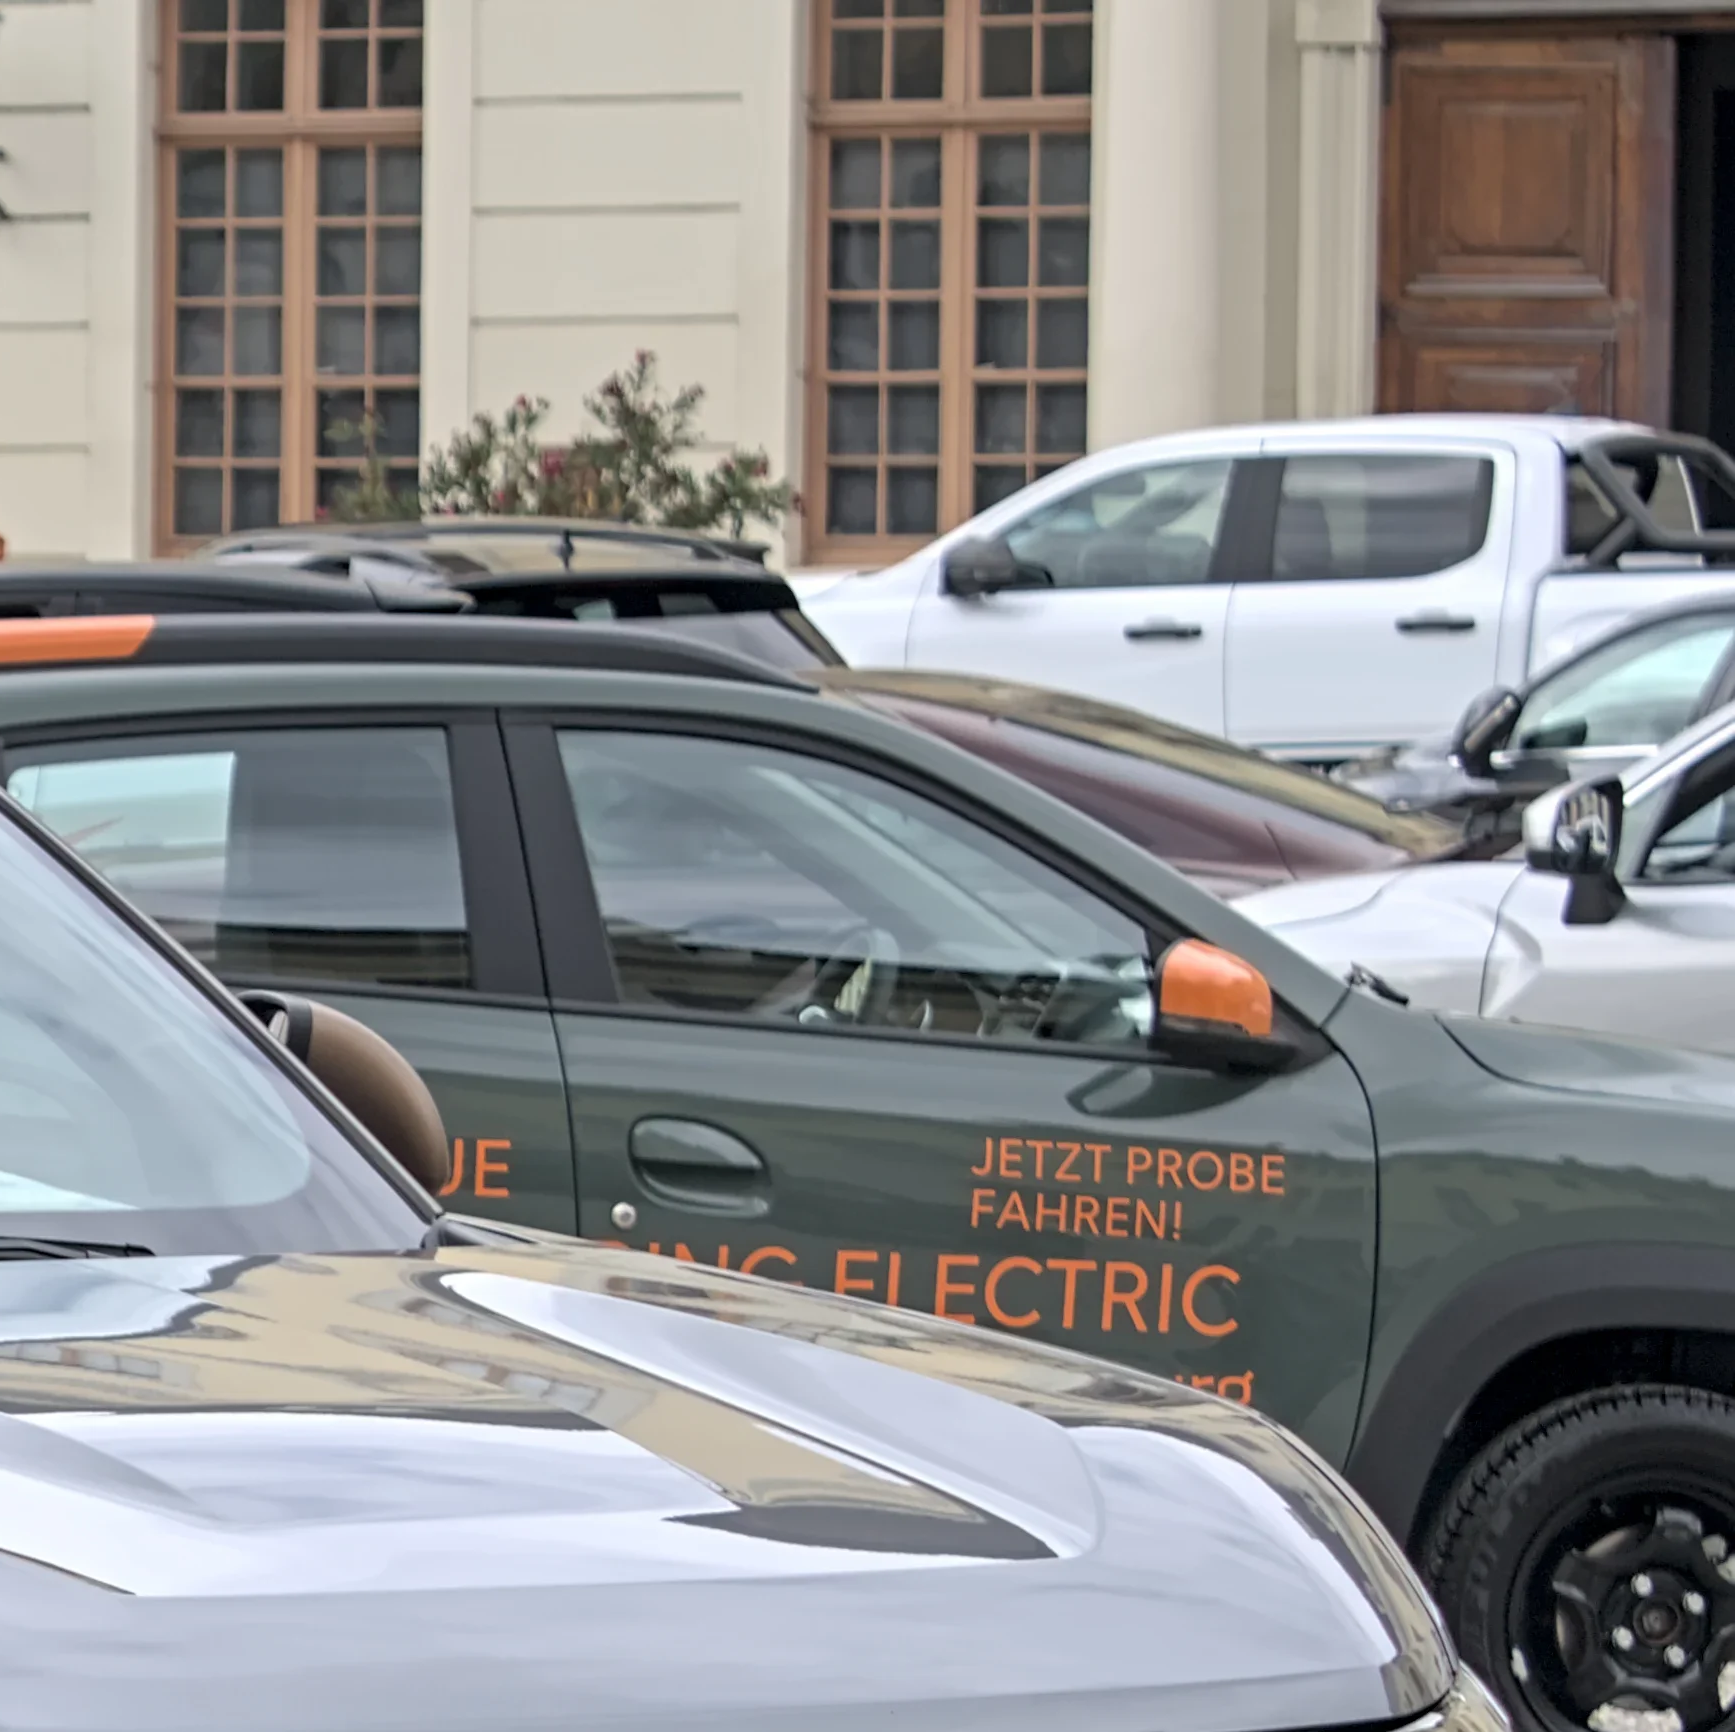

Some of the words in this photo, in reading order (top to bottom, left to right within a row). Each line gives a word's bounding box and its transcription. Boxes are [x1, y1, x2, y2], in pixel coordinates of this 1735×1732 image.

[971, 1137, 1112, 1184] JETZT
[1127, 1146, 1285, 1196] PROBE
[971, 1188, 1183, 1240] FAHREN!
